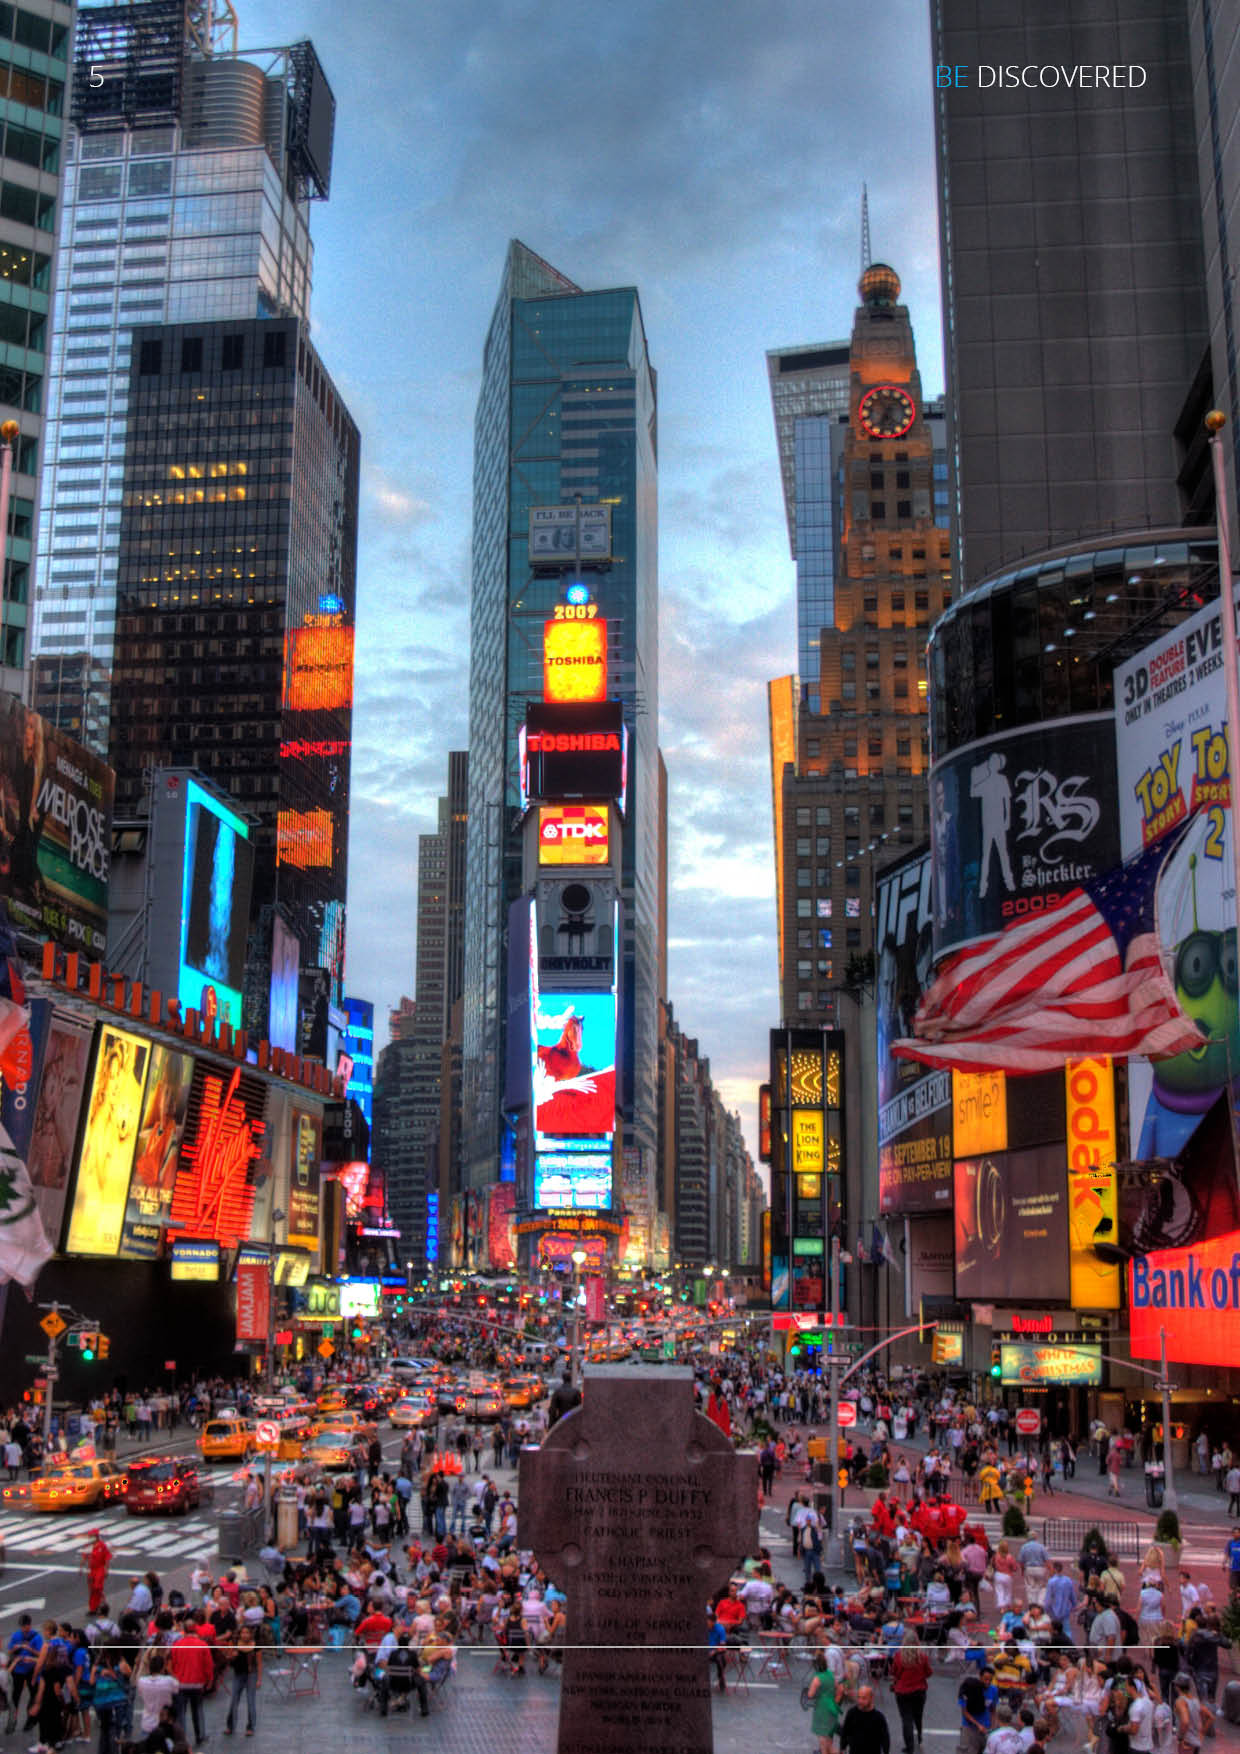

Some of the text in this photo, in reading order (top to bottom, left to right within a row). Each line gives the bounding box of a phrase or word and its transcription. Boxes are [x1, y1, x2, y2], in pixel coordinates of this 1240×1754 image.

[553, 604, 598, 620] 2009
[547, 656, 604, 666] TOSHIBA
[1149, 639, 1184, 675] DOUBLE
[1124, 667, 1148, 706] 3D
[1150, 655, 1185, 690] FEATURE
[1125, 704, 1142, 726] ONLY
[1143, 695, 1152, 715] IN
[1152, 674, 1187, 708] THEATRES
[1189, 670, 1195, 688] 2
[527, 734, 620, 752] TOSHIBA
[1135, 738, 1182, 824] TOY
[37, 778, 105, 847] MELROSE
[1014, 767, 1101, 864] RS
[1145, 797, 1182, 843] STORY
[557, 823, 604, 839] TDK
[1204, 804, 1225, 861] 2
[70, 833, 109, 883] PLACE
[1001, 893, 1061, 917] 2009
[914, 1071, 950, 1115] BELFORT
[959, 1083, 1000, 1125] smile?
[799, 1123, 817, 1132] THE
[796, 1133, 820, 1148] LION
[894, 1137, 937, 1167] SEPTEMBER
[939, 1135, 951, 1160] 19
[796, 1150, 821, 1165] KING
[903, 1160, 952, 1184] PAY-PER-VIEW
[173, 1247, 218, 1257] VORNADO
[1132, 1251, 1240, 1309] Bank of
[240, 1272, 255, 1336] JAMJAM
[1000, 1332, 1102, 1344] MARQUIS
[1034, 1347, 1077, 1361] WHITE
[1019, 1360, 1096, 1380] CHRISTMAS
[565, 1487, 633, 1504] FRANCIS
[655, 1489, 713, 1505] DUFFY
[583, 1526, 692, 1539] CATHOLIC PRIEST
[674, 1687, 711, 1699] GUARD
